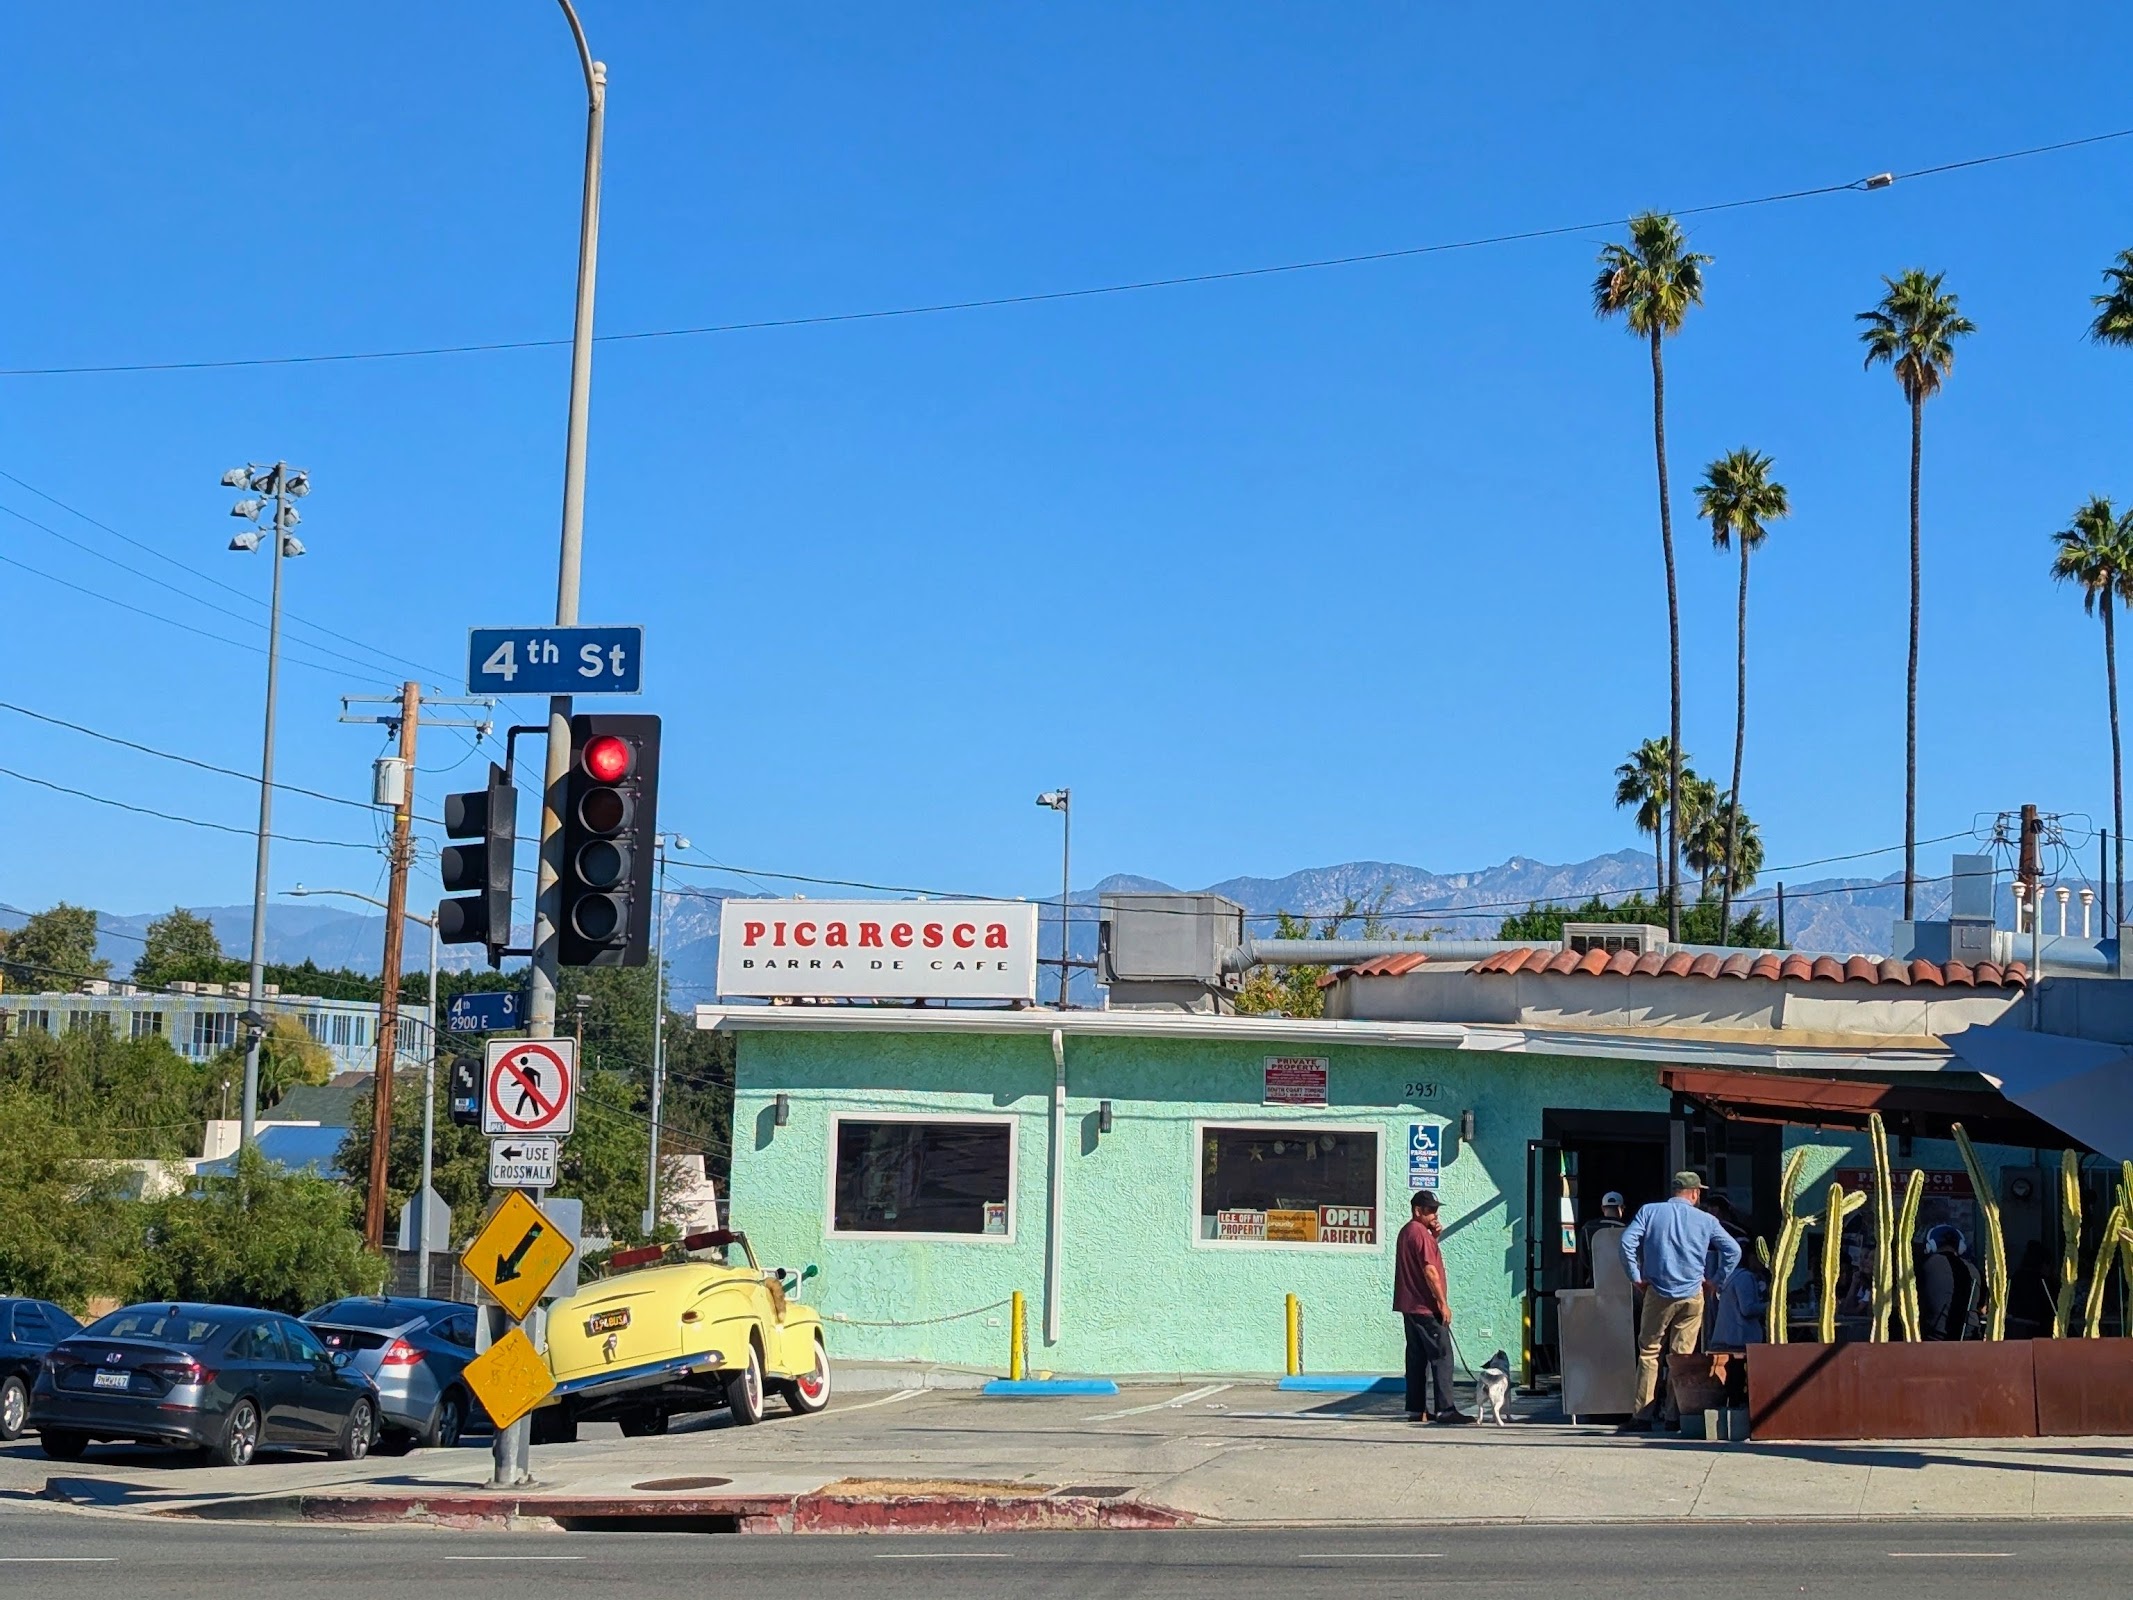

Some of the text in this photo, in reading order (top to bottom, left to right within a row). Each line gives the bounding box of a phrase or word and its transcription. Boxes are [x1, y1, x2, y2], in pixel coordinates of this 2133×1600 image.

[482, 639, 626, 682] 4th St
[743, 959, 1009, 972] BARRA DE CAFE
[451, 994, 519, 1016] 4th St
[450, 1014, 489, 1030] 2900 E
[1271, 1063, 1321, 1071] PROPERTY
[1405, 1082, 1438, 1098] 2931
[525, 1147, 550, 1161] USE
[493, 1165, 552, 1180] CROSSWALK
[1239, 1214, 1253, 1223] OFF
[1252, 1214, 1264, 1224] MY
[1325, 1208, 1370, 1227] OPEN
[1221, 1224, 1264, 1235] PROPERTY
[1321, 1229, 1373, 1244] ABIERTO
